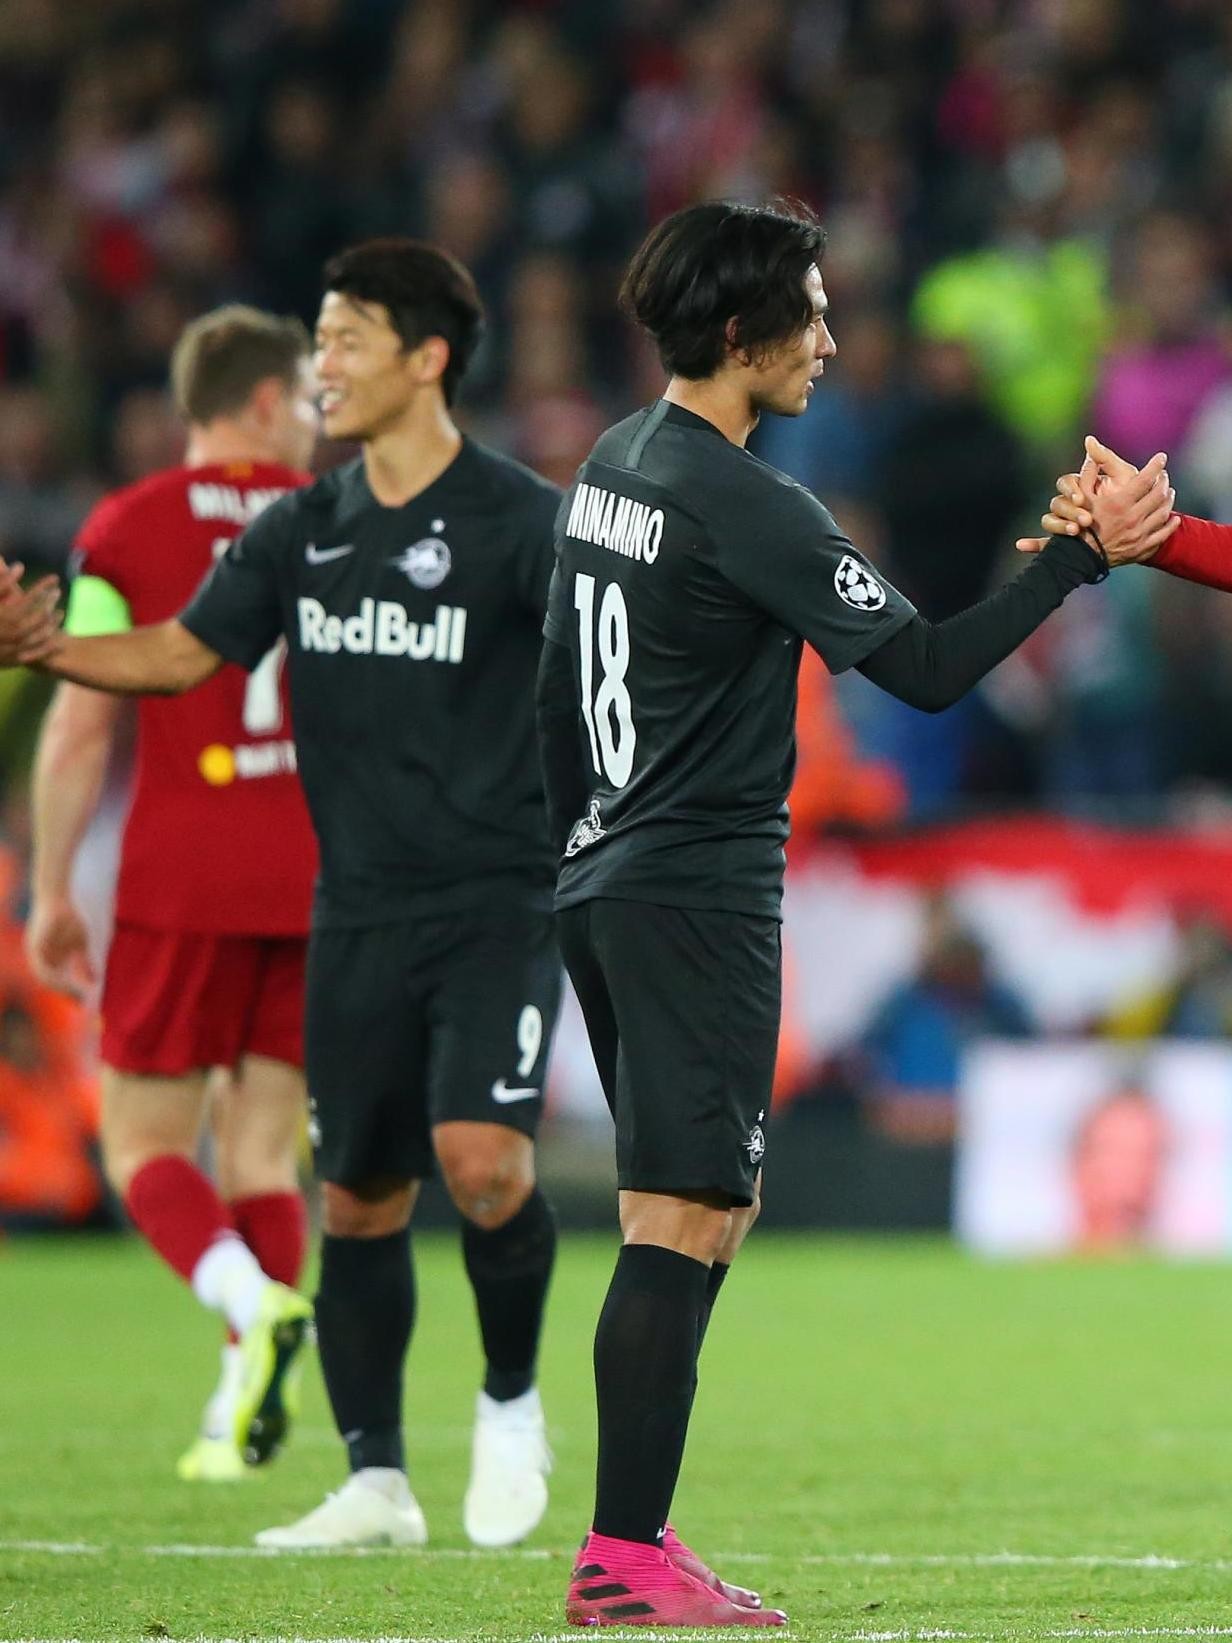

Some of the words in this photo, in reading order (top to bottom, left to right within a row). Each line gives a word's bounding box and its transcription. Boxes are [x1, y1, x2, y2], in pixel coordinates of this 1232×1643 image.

[566, 483, 664, 565] MINAMINO
[574, 572, 637, 789] 18
[517, 1004, 542, 1078] 9
